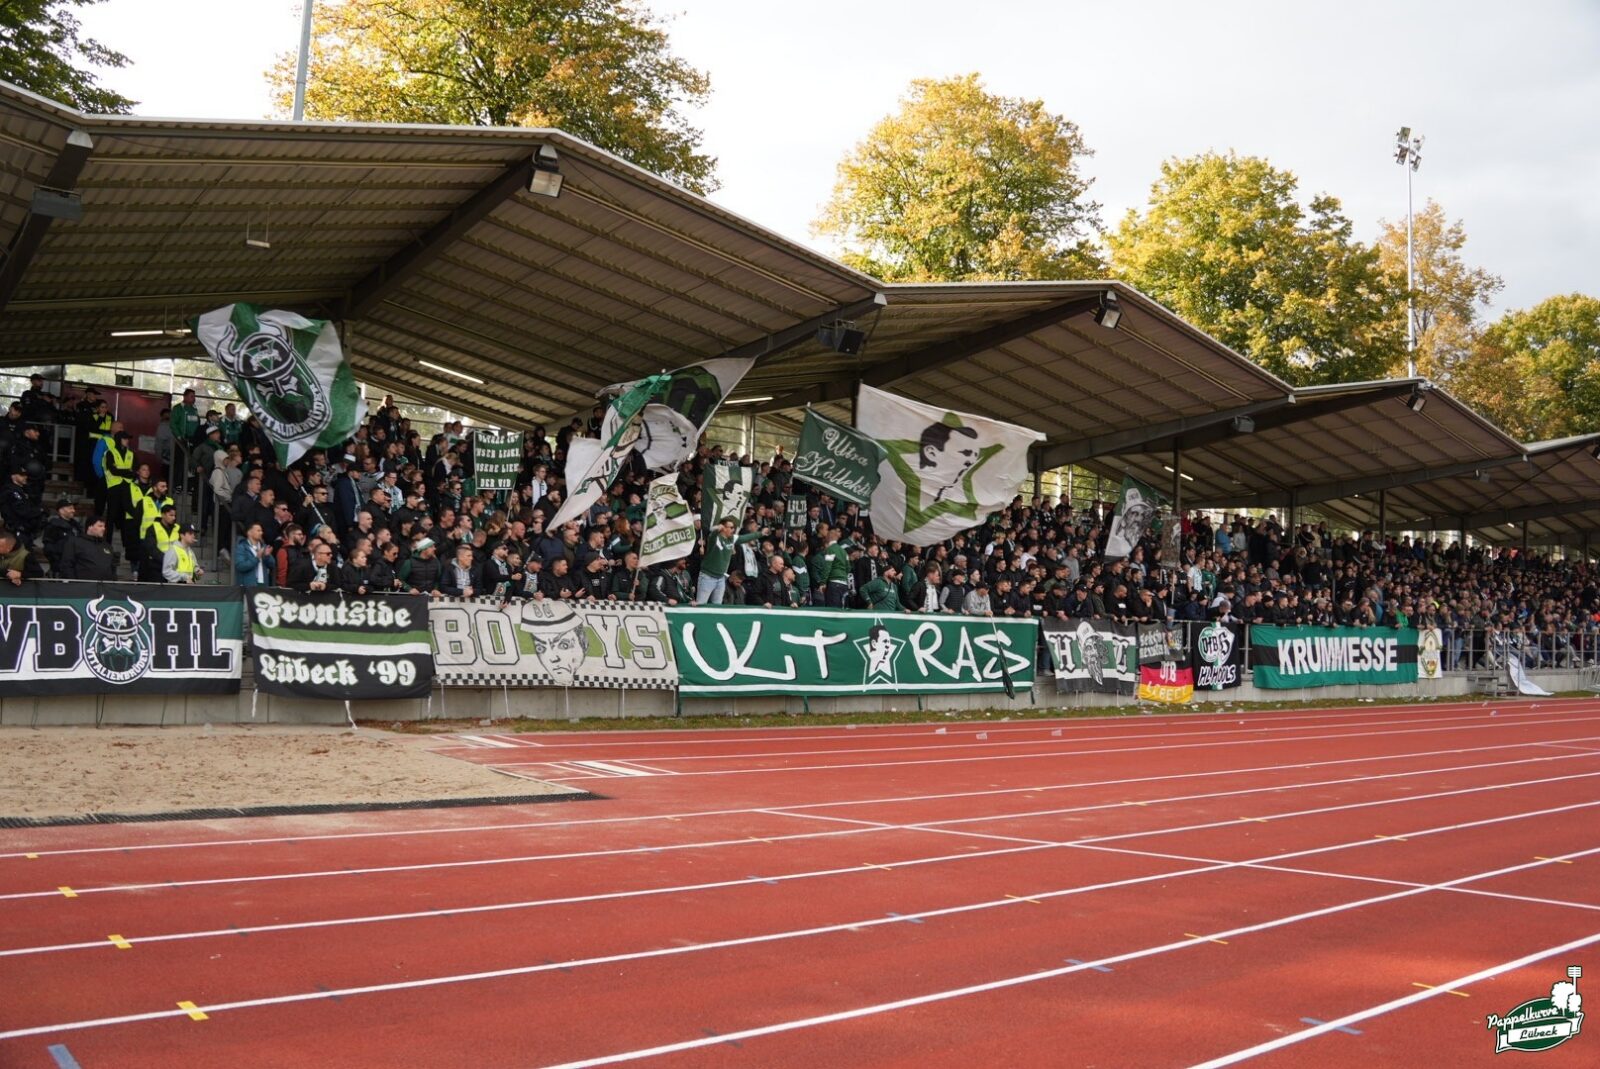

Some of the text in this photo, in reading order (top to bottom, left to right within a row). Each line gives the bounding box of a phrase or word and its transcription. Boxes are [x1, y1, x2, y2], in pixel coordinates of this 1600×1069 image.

[822, 427, 868, 466] Ultra
[795, 451, 872, 497] Kollekti
[666, 529, 692, 543] 2002
[259, 653, 358, 685] Lübeck
[1277, 636, 1398, 675] KRUMMESSE
